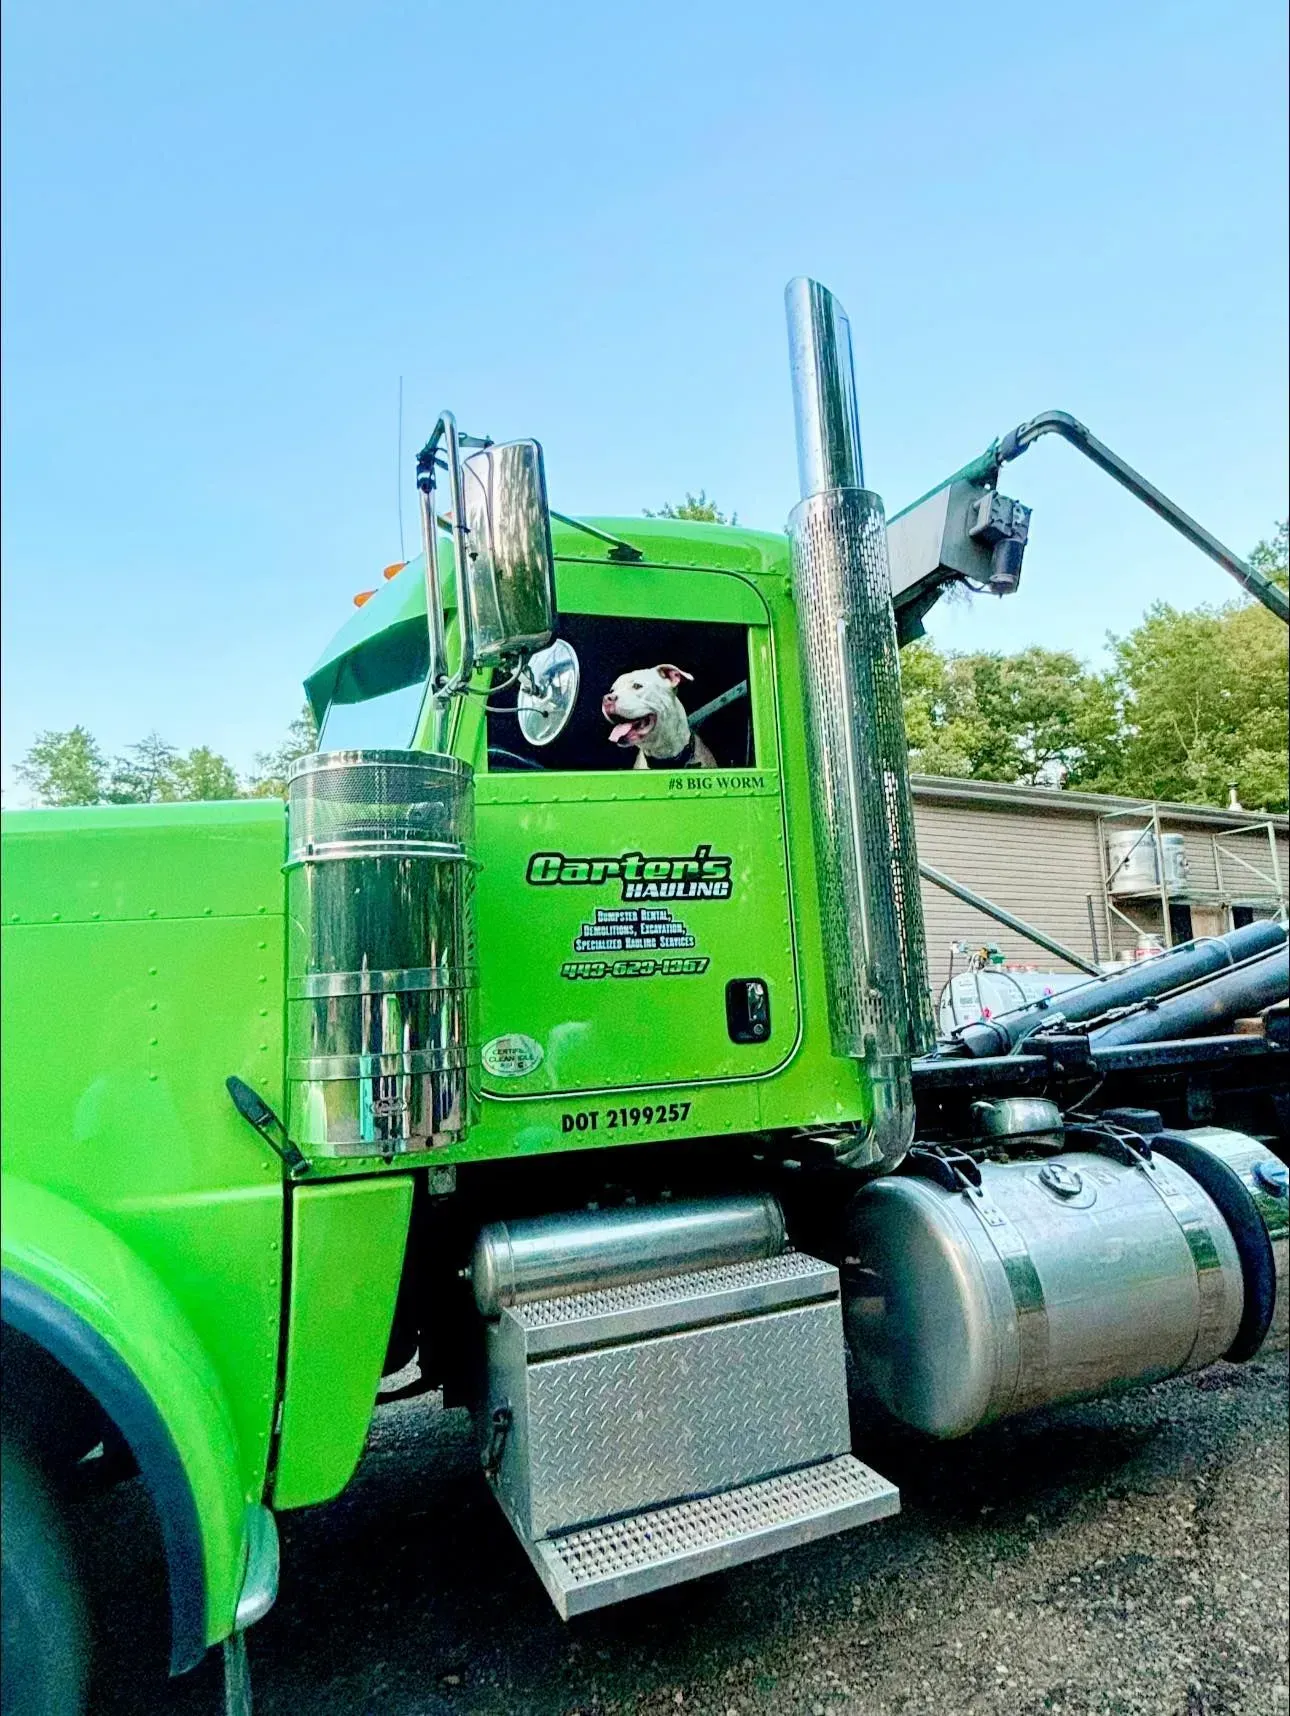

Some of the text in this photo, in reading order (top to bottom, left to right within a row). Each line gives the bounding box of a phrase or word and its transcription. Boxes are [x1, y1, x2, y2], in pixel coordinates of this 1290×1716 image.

[668, 776, 764, 790] #8 BIG WORM
[528, 846, 731, 883] Carter's
[625, 881, 729, 898] HAULING
[597, 910, 638, 922] DUMPSTER
[575, 935, 695, 951] SPECIALIZED HAULING SERVICES
[562, 959, 708, 978] 443-623-1367
[561, 1102, 692, 1133] DOT 2199257
